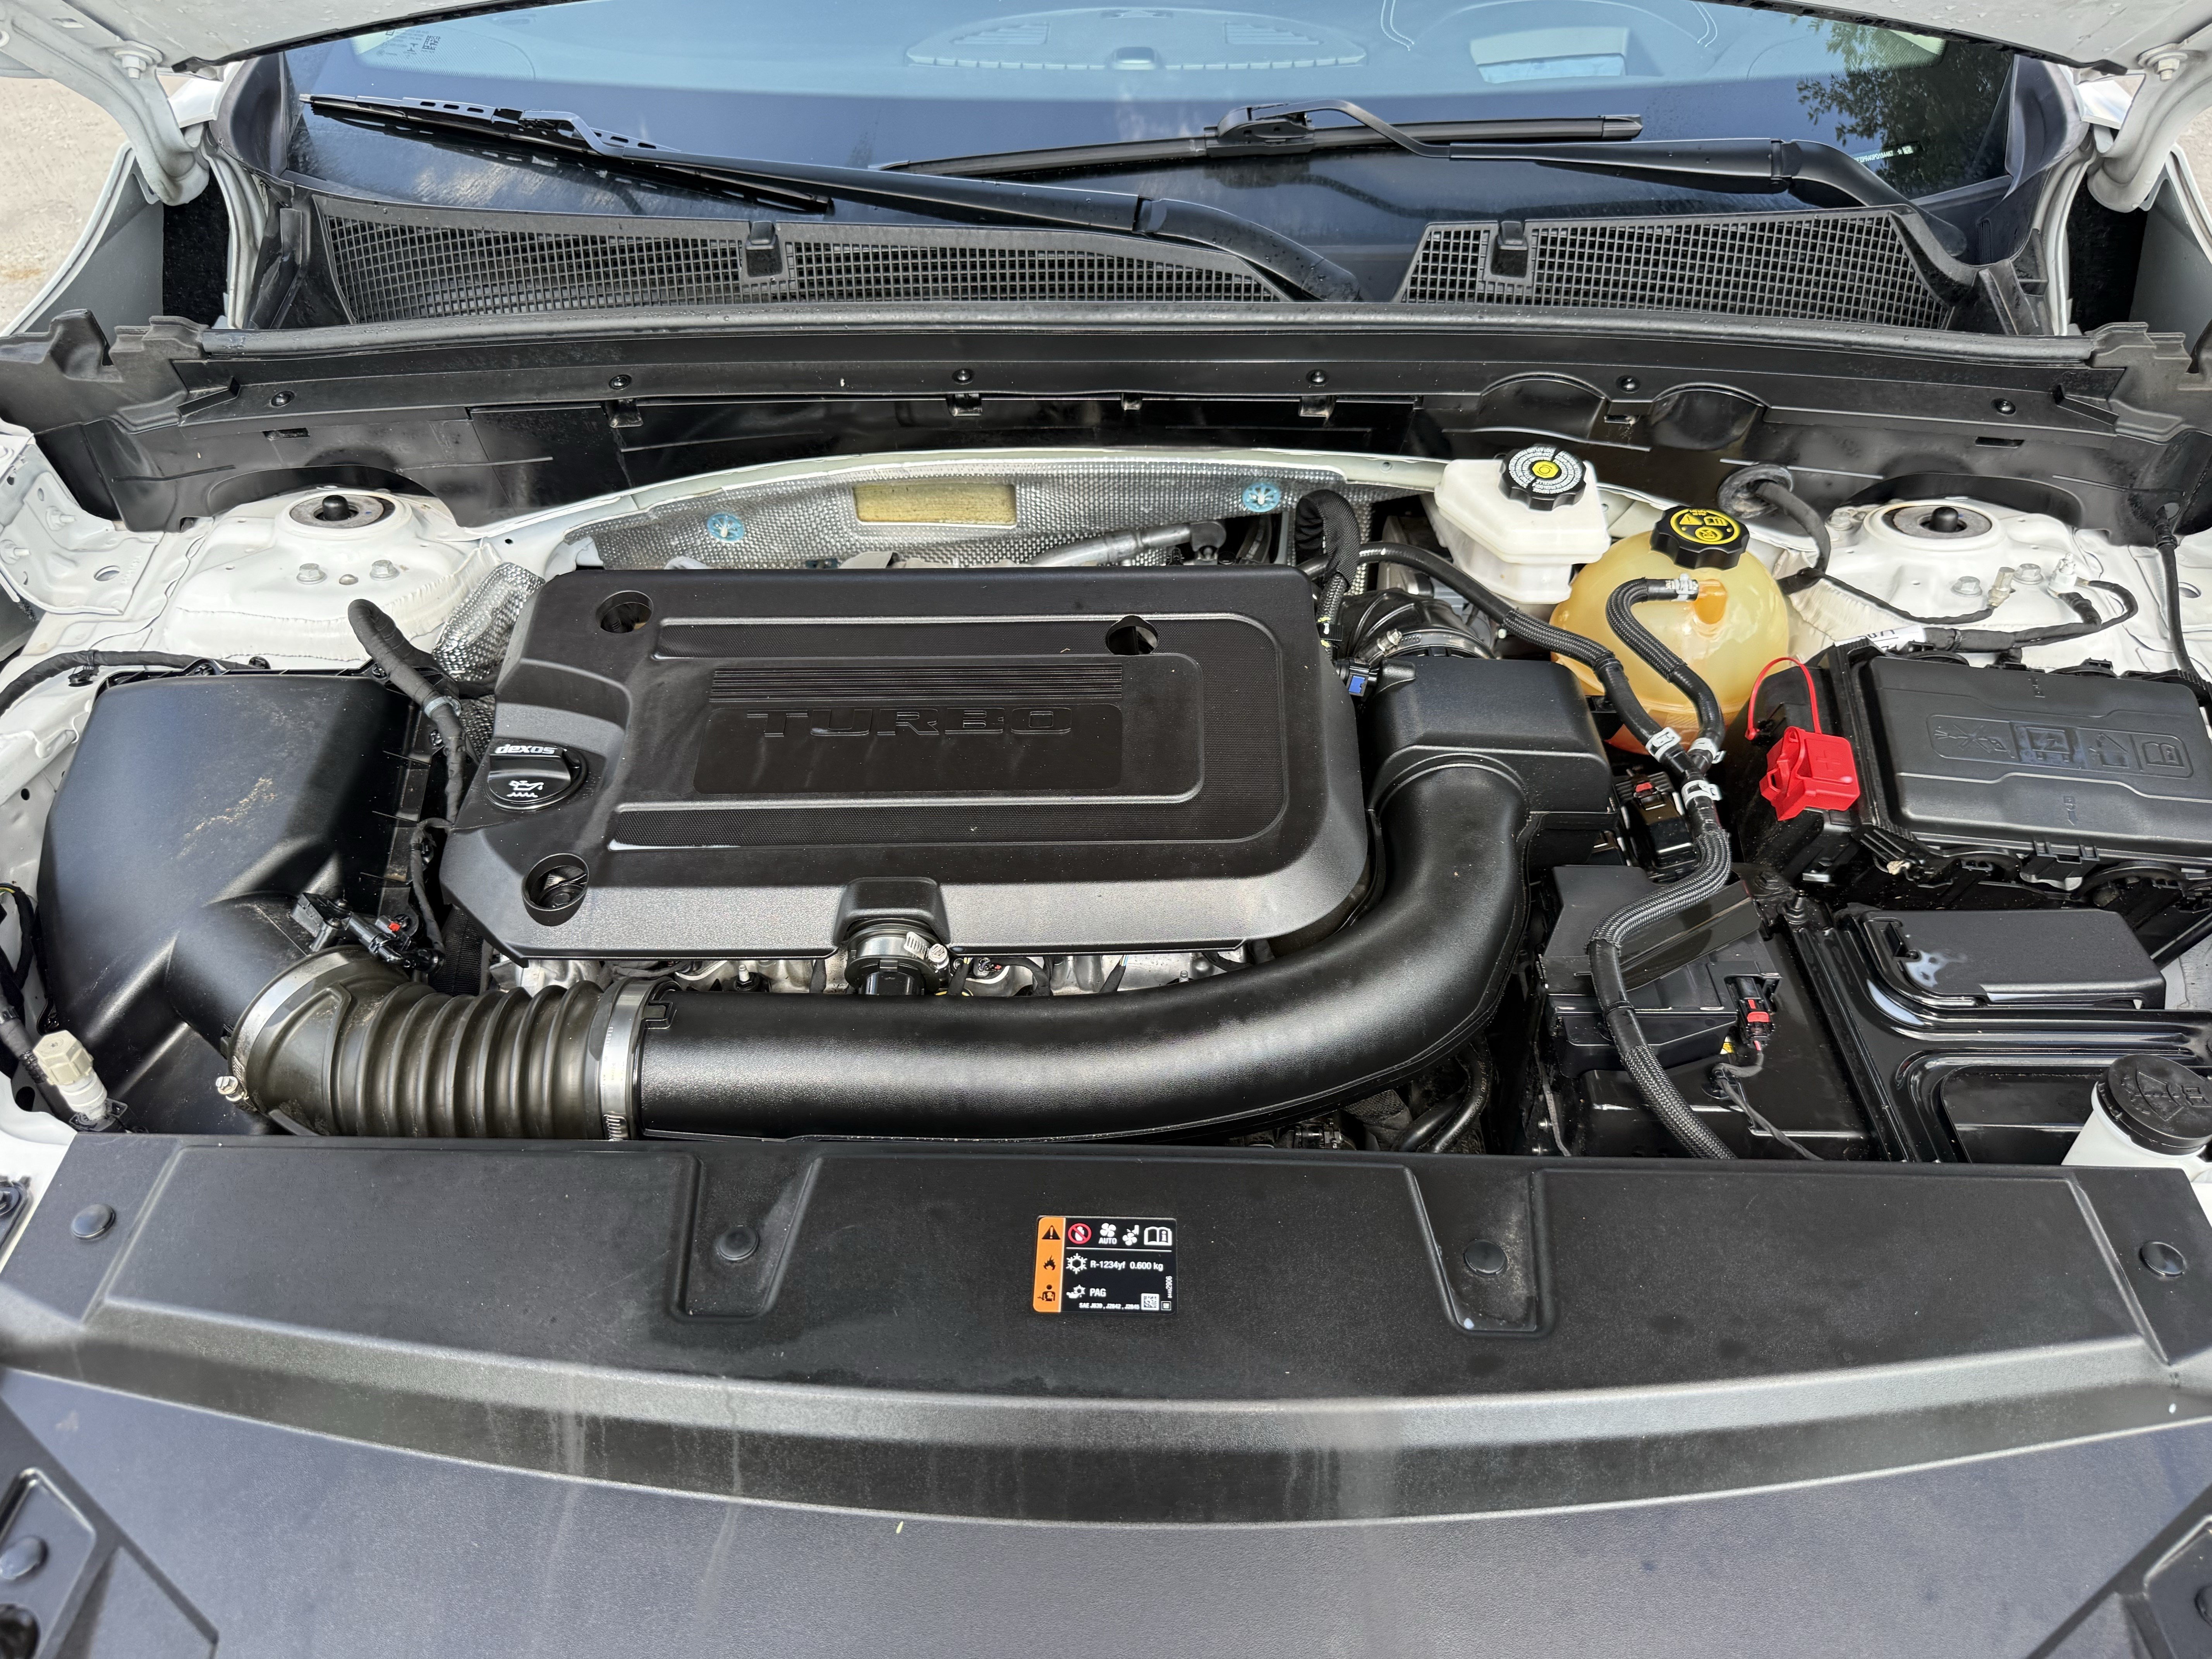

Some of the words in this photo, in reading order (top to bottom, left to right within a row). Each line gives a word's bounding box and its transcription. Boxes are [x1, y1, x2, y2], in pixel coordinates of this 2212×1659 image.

[747, 707, 1072, 737] TURBO
[495, 744, 556, 754] dexos
[1090, 1261, 1126, 1271] R-1234yf
[1153, 1262, 1163, 1272] kg
[1089, 1288, 1107, 1297] PAG
